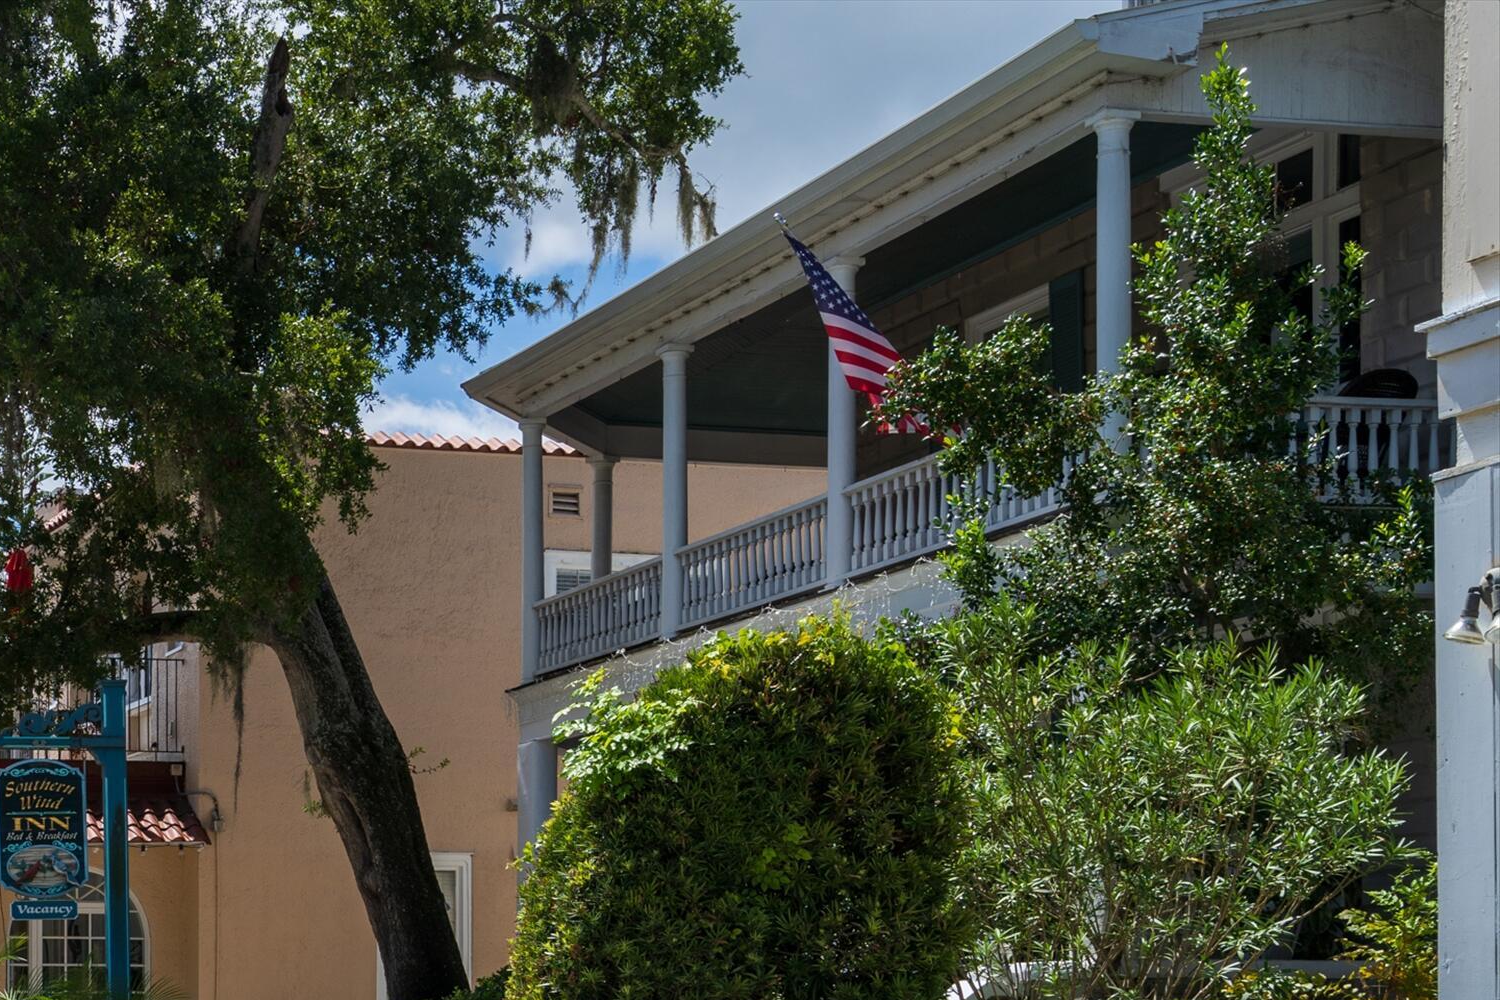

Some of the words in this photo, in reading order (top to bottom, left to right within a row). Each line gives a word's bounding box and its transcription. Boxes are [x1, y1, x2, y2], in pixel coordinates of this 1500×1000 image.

[4, 778, 76, 798] Southern
[19, 795, 64, 811] Wind
[11, 815, 71, 832] INN
[5, 831, 23, 842] Bed
[25, 832, 34, 842] &
[36, 831, 78, 842] Breakfast
[16, 904, 74, 918] Vacancy
